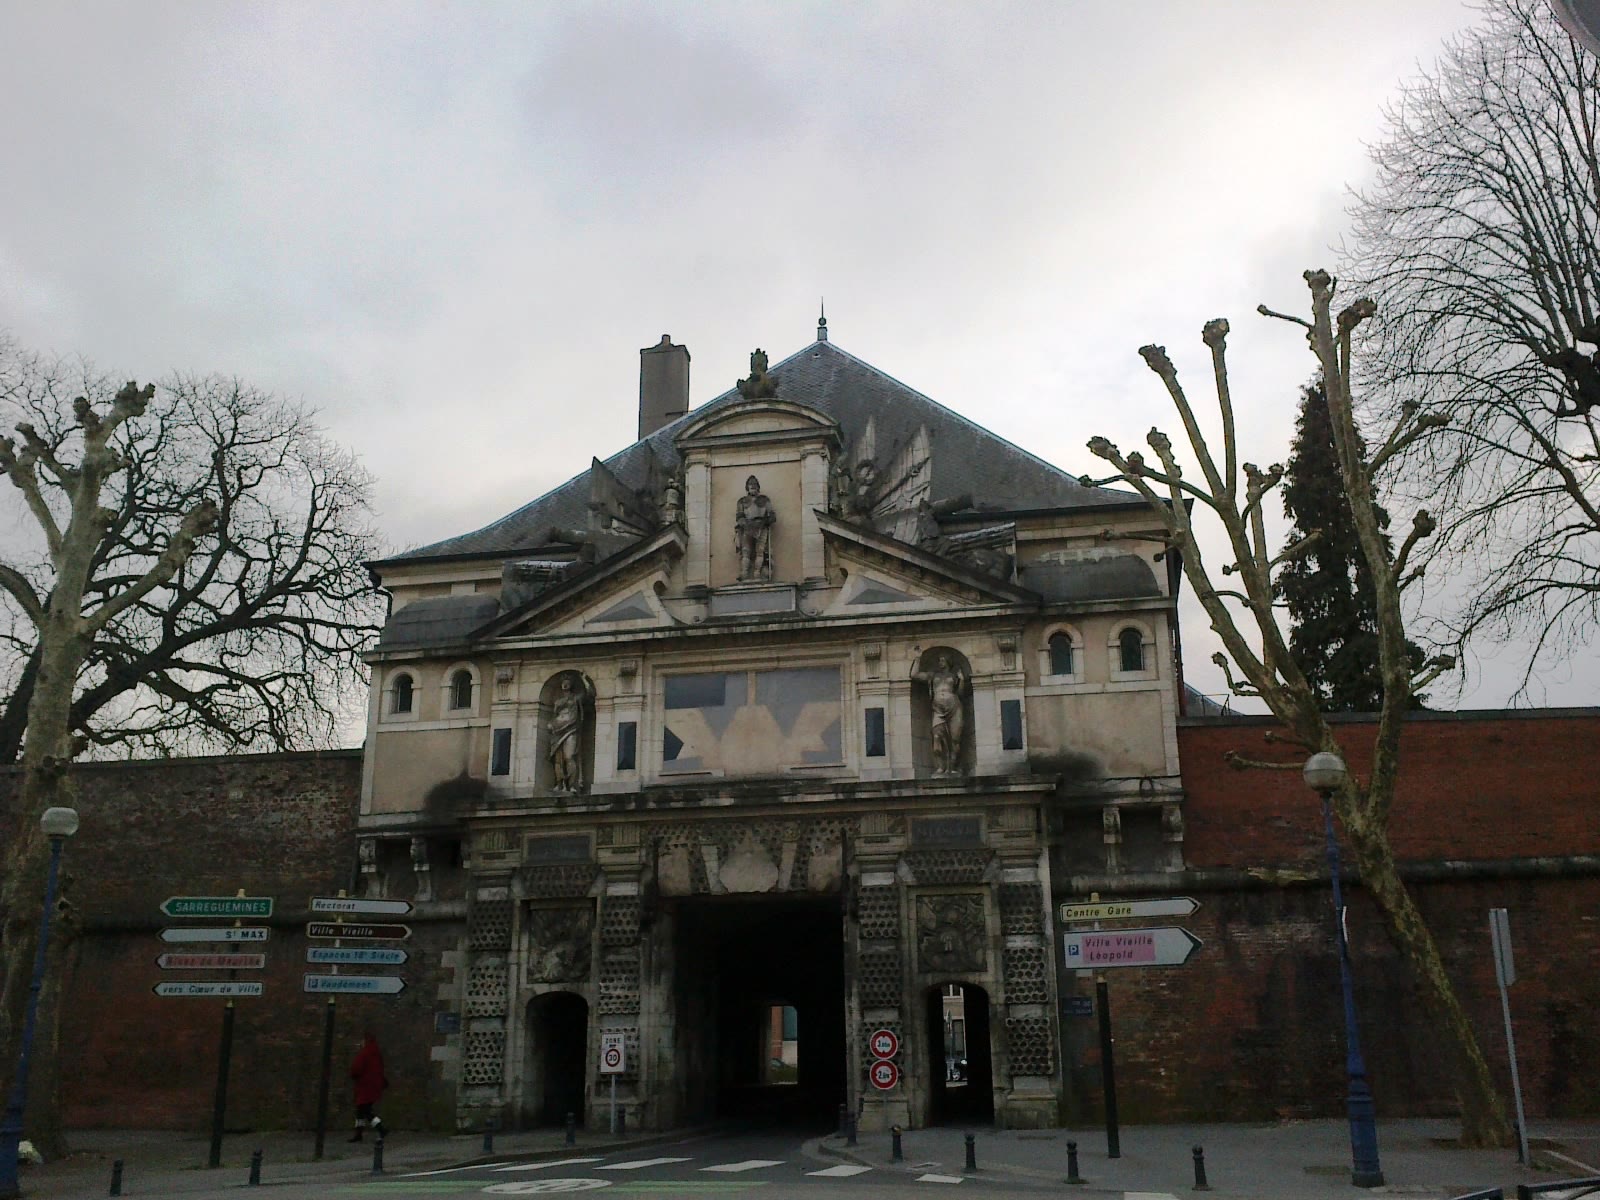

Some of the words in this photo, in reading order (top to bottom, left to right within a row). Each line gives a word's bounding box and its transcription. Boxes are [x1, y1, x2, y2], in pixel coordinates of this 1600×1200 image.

[175, 902, 266, 912] SARREGUEMINES
[315, 902, 355, 910] Rectorat
[1066, 909, 1100, 917] Centre
[1107, 906, 1132, 915] Gare
[241, 930, 264, 938] MAX
[312, 926, 334, 935] Ville
[342, 927, 374, 936] Vieille
[1085, 938, 1110, 948] Ville
[1116, 936, 1153, 946] Vieille
[163, 985, 183, 993] vers
[239, 984, 260, 993] Ville
